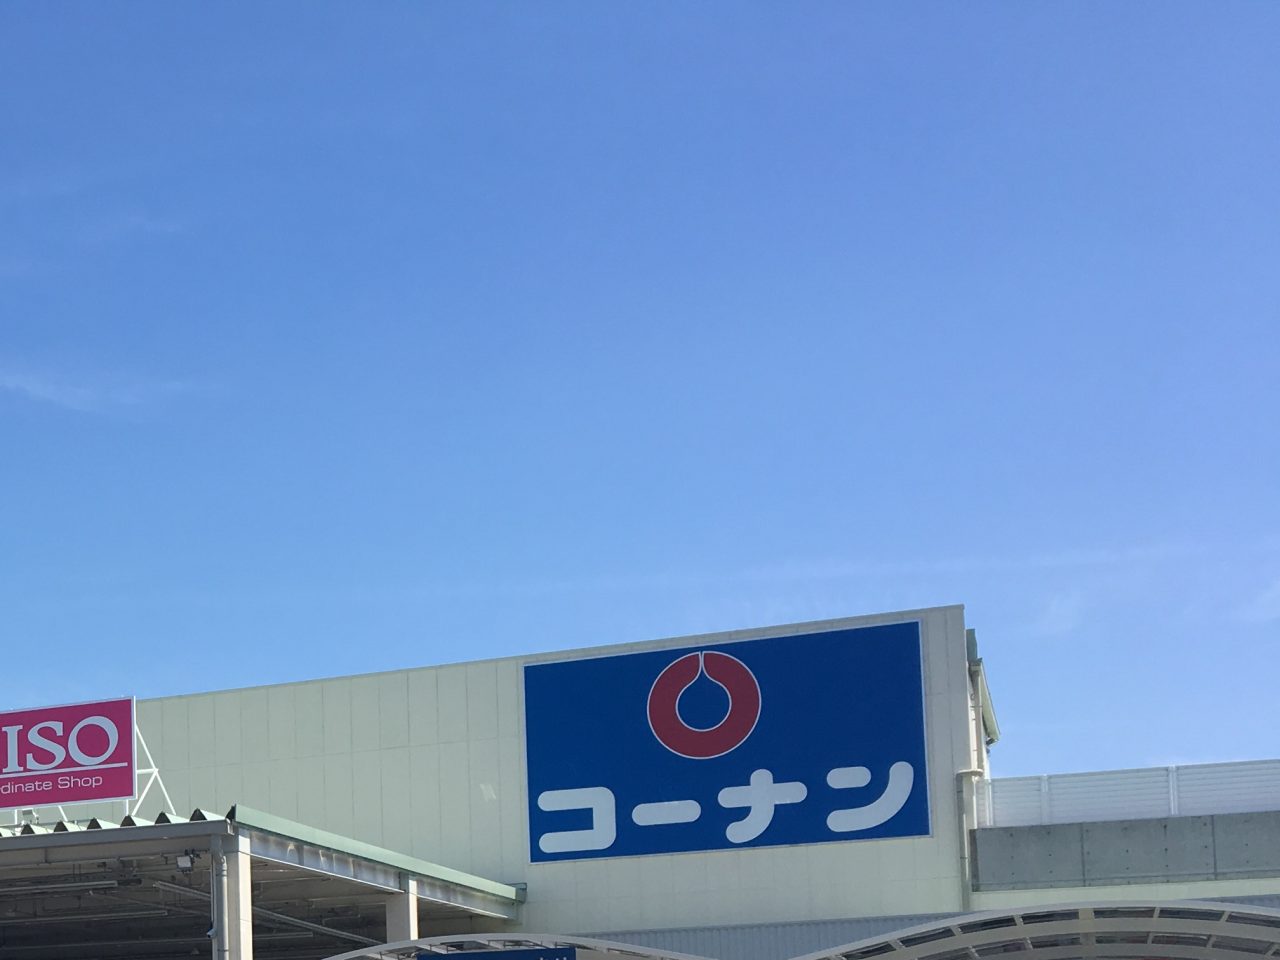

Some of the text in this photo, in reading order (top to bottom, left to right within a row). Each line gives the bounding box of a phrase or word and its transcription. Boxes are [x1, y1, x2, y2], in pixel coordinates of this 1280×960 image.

[57, 775, 103, 789] Shop
[537, 761, 914, 853] コーナン
